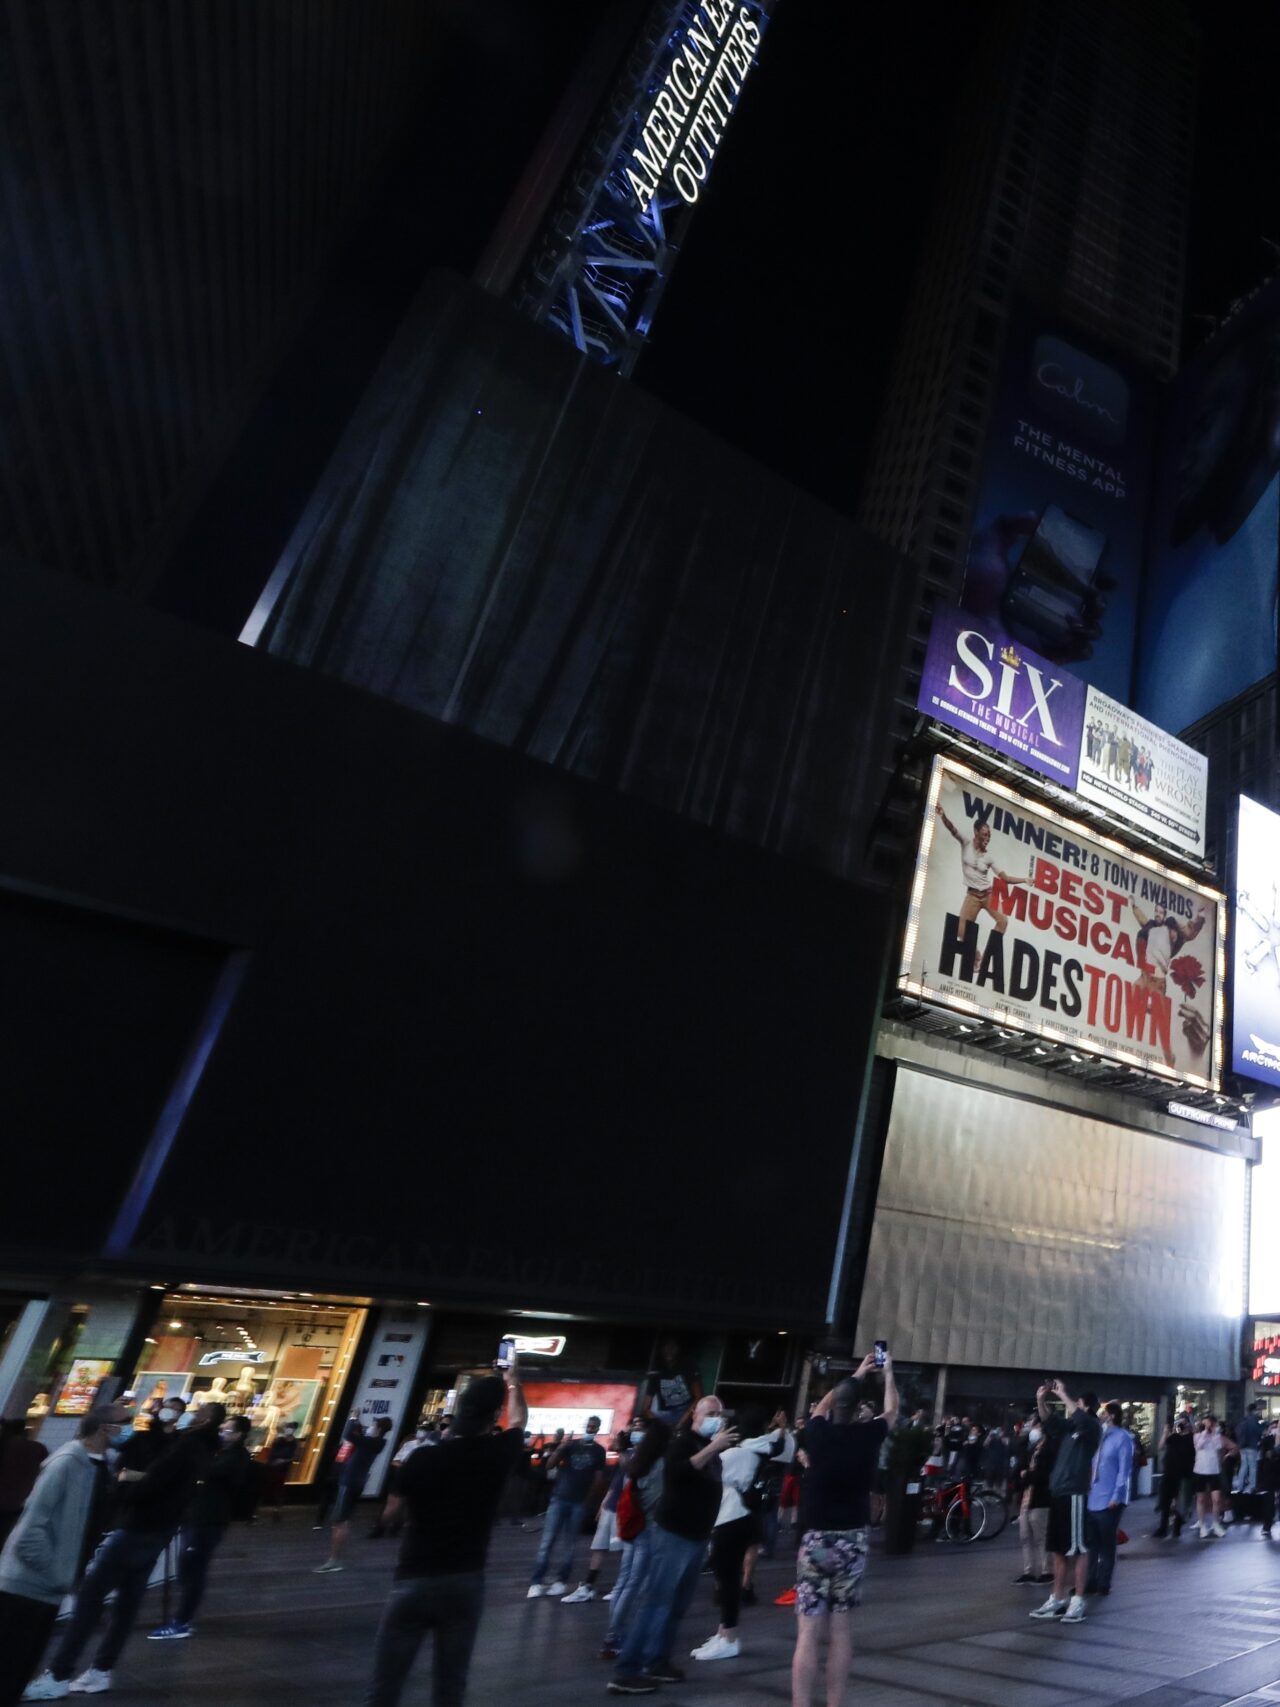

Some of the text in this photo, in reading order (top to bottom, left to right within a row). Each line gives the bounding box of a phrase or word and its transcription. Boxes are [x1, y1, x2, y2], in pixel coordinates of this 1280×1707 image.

[626, 15, 715, 213] AMERICAN
[673, 7, 761, 203] OUTFITTERS
[1013, 435, 1126, 499] FITNESS APP
[1017, 419, 1127, 486] THE MENTAL
[948, 631, 1064, 747] SIX
[971, 700, 1040, 747] THE MUSICAL
[1089, 702, 1201, 772] AND INTERNATIONAL PHENOMENON
[1093, 696, 1135, 724] BROADWAY'S
[1167, 737, 1188, 757] SMASH
[1093, 777, 1107, 790] NEW
[1108, 786, 1128, 802] WORLD
[1155, 778, 1202, 817] WRONG
[962, 790, 1088, 870] WINNER!
[1090, 854, 1100, 876] 8
[1103, 858, 1138, 894] TONY
[1141, 878, 1193, 919] AWARDS
[1033, 857, 1129, 924] BEST
[989, 876, 1156, 975] MUSICAL
[937, 911, 1175, 1062] HADESTOWN
[142, 1214, 448, 1277] AMERICAN
